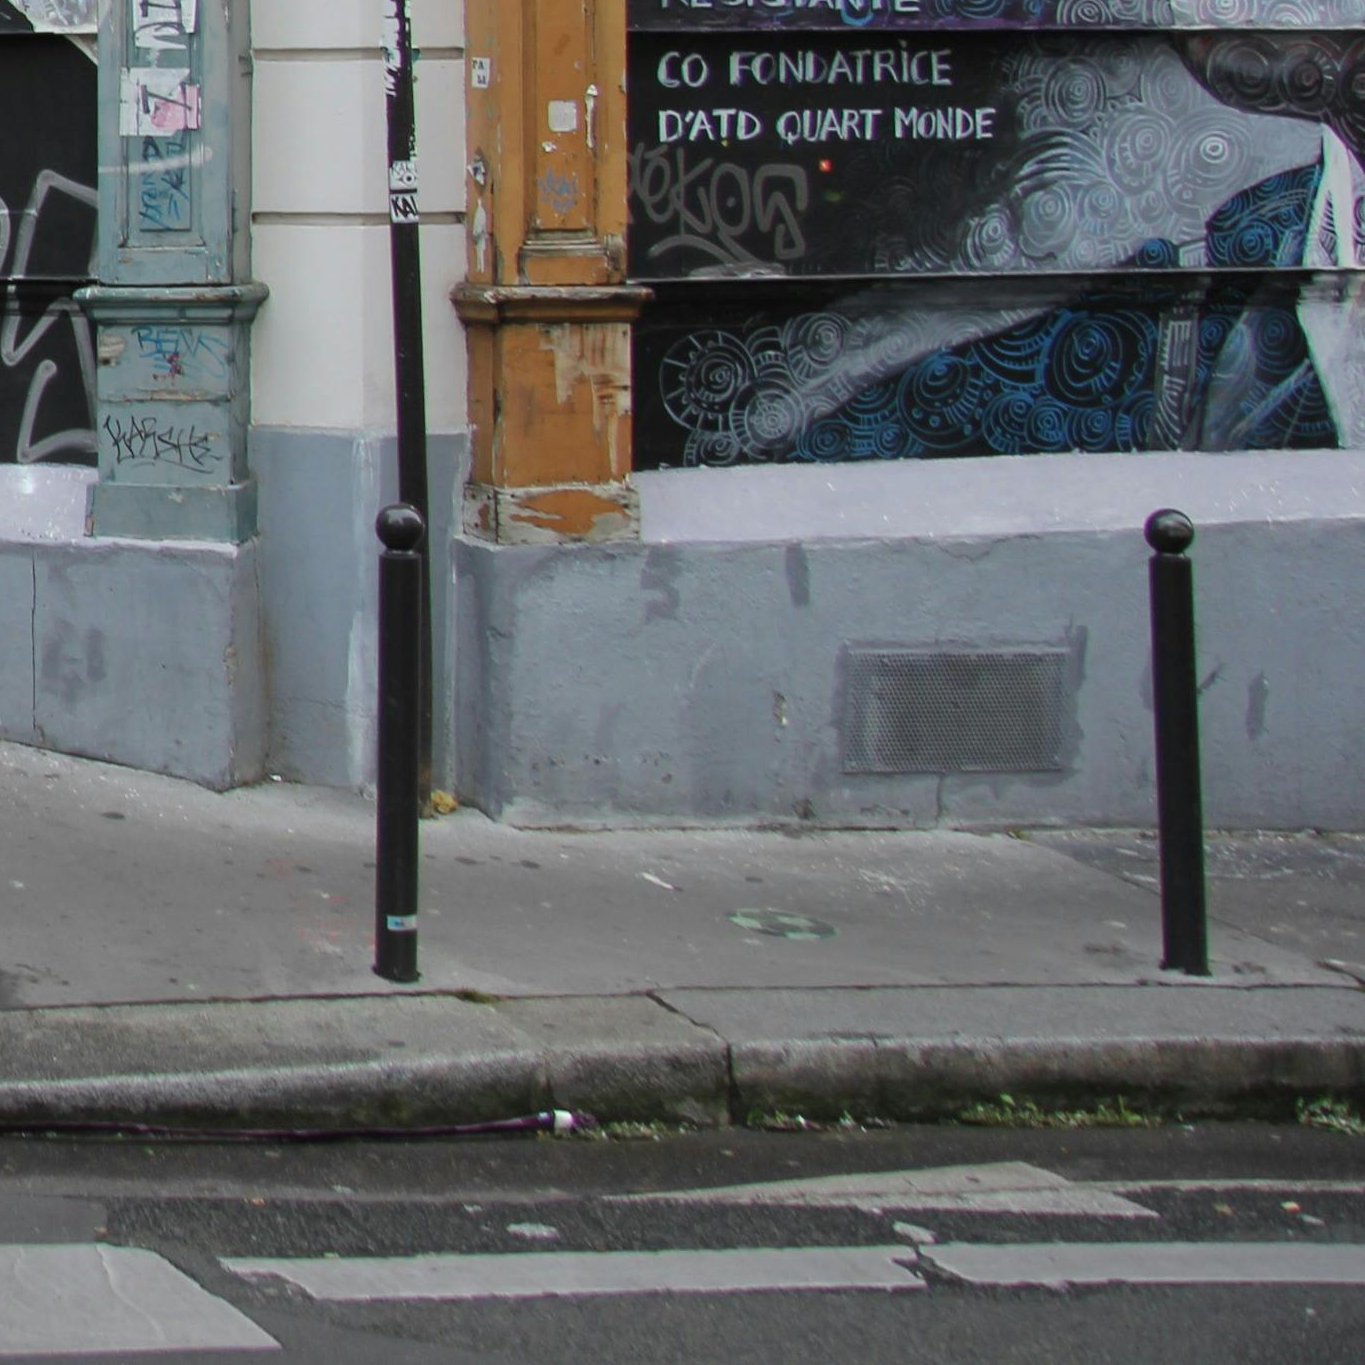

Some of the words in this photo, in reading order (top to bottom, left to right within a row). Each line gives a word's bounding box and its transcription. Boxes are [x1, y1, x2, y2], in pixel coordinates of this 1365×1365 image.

[658, 50, 707, 88] CO
[730, 40, 951, 86] FONDATRICE
[658, 108, 761, 142] D'ATD
[777, 108, 881, 144] QUART
[895, 107, 996, 139] MONDE
